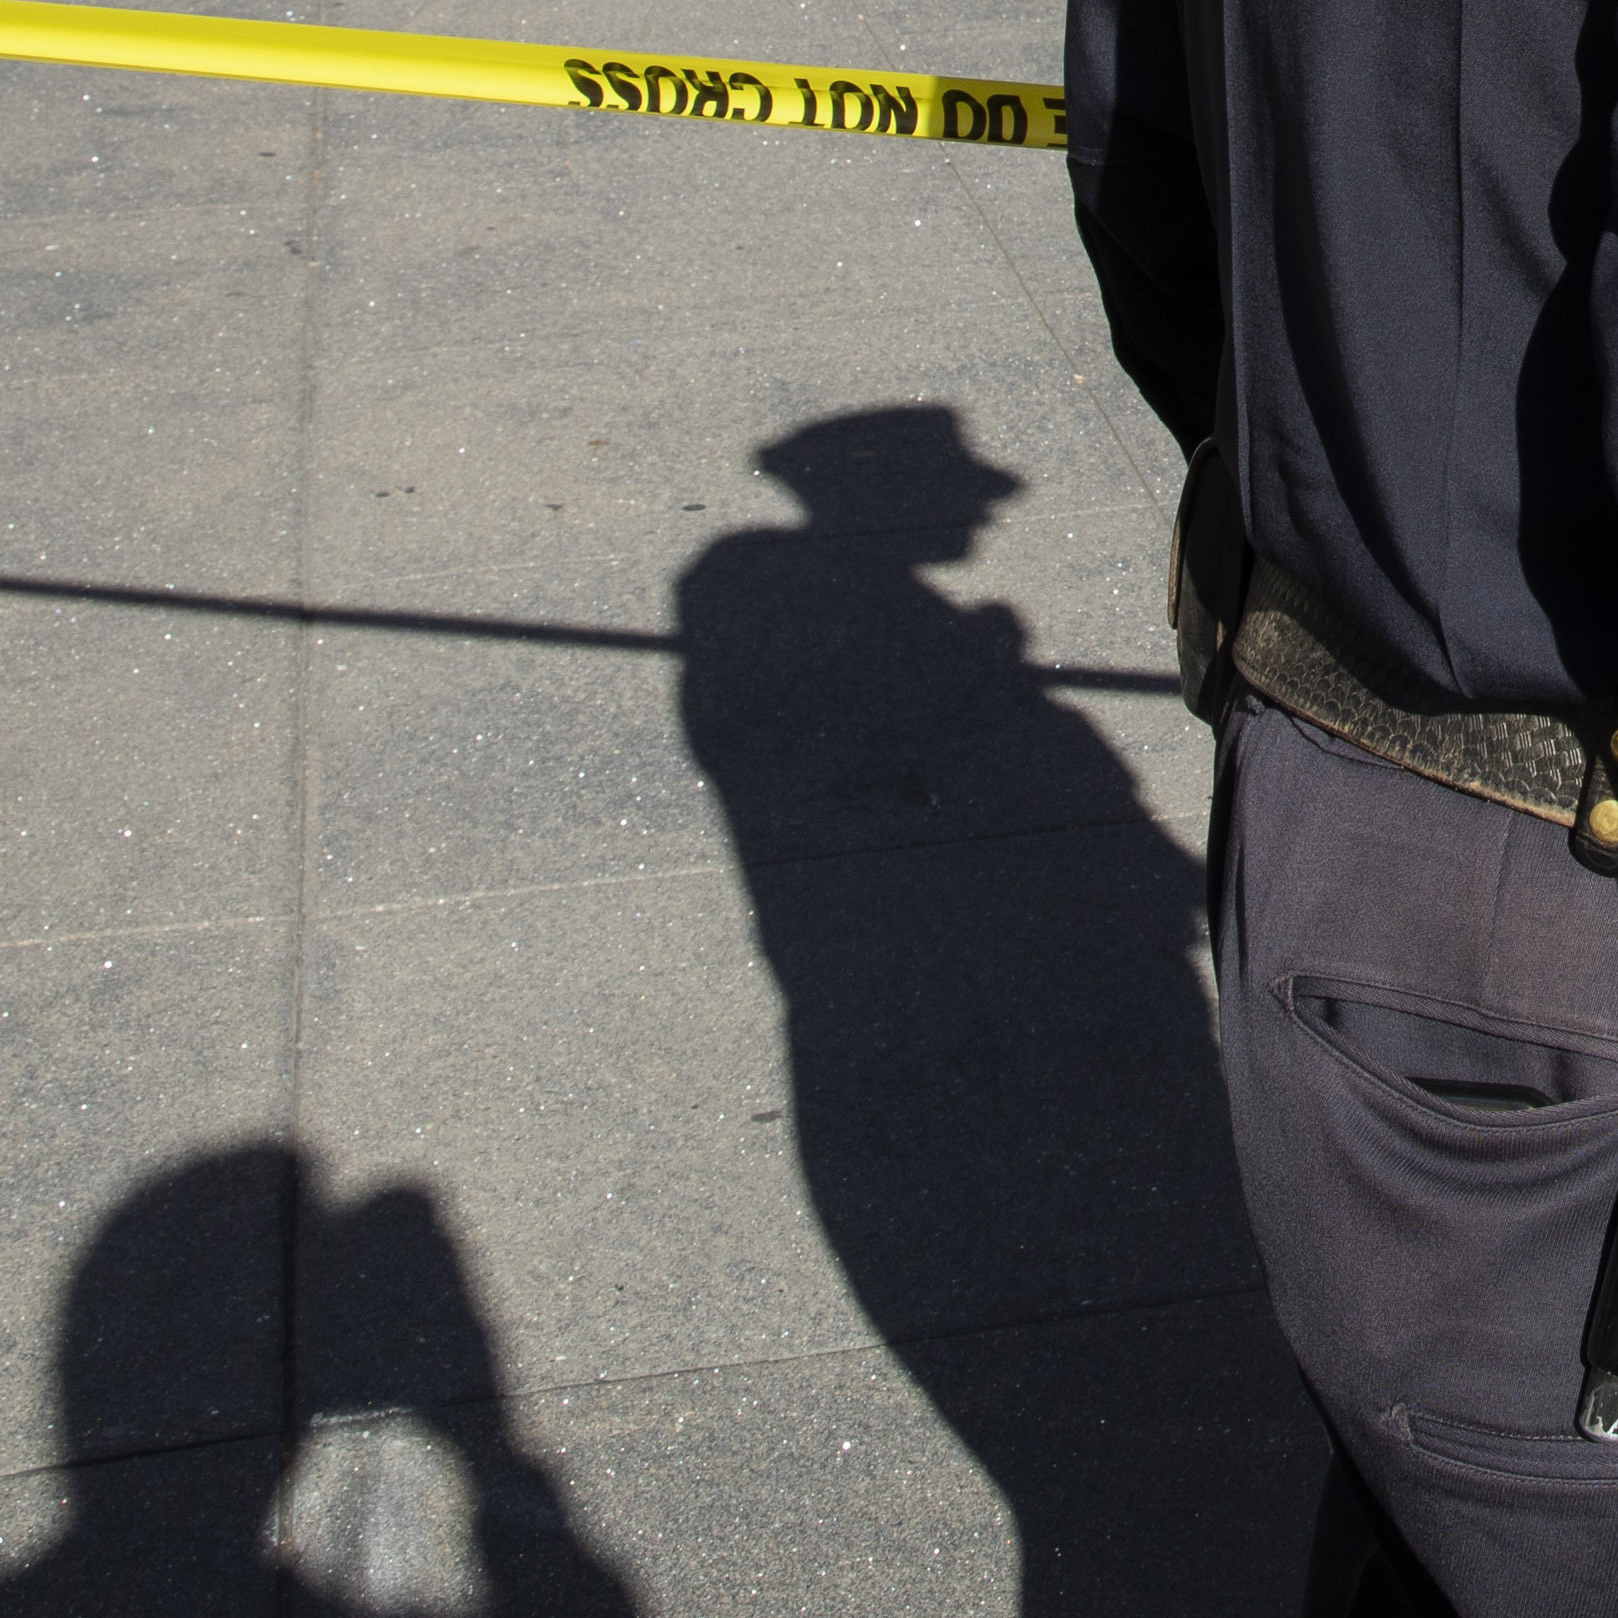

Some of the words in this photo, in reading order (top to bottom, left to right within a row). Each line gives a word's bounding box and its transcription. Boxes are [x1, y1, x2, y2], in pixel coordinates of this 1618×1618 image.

[563, 58, 773, 123] CROSS
[787, 77, 918, 137] NOT
[941, 88, 1029, 145] DO
